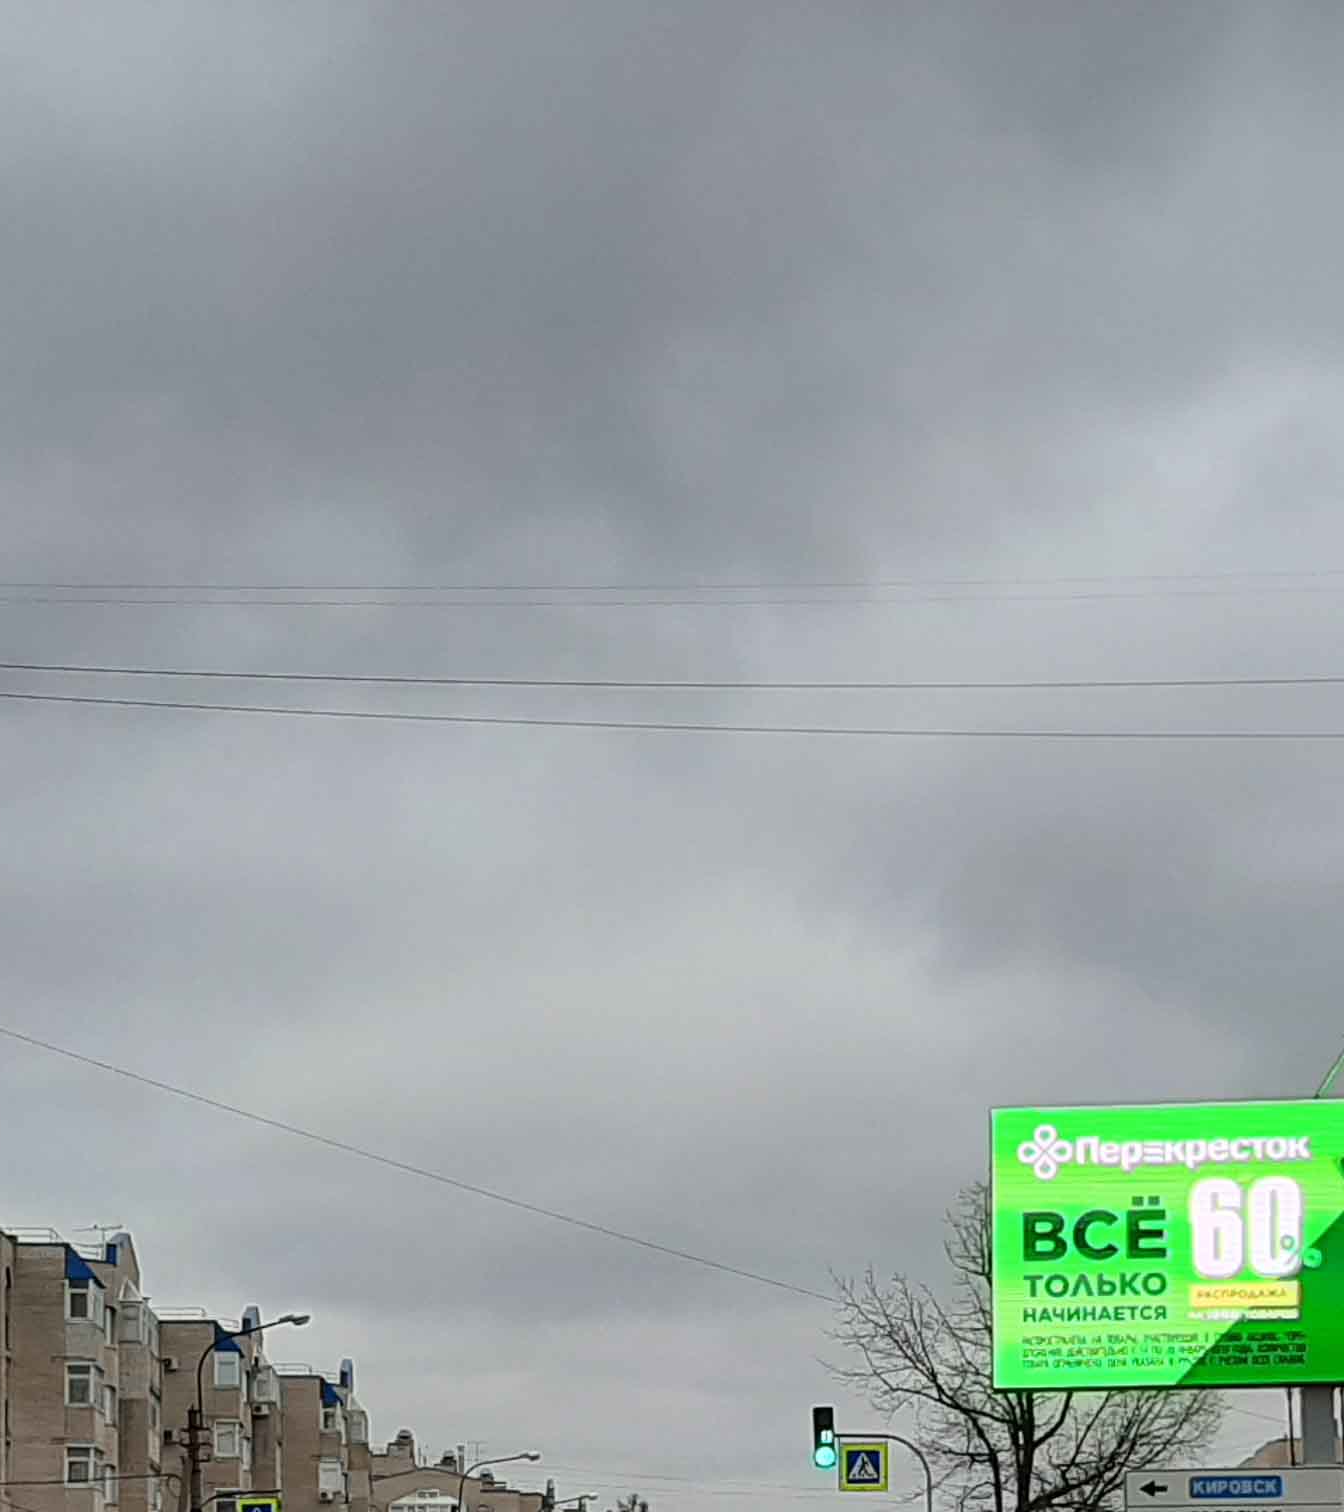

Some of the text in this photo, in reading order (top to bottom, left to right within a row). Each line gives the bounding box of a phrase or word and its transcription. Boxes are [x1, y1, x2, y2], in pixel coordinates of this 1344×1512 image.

[1076, 1136, 1312, 1173] Перекресток
[1022, 1195, 1168, 1263] ВСЁ
[1023, 1272, 1168, 1299] ТОЛЬКО
[1196, 1287, 1288, 1300] РАСПРОДАЖА
[1022, 1304, 1168, 1324] НАЧИНАЕТСЯ
[1192, 1479, 1278, 1495] КИРОВСК
